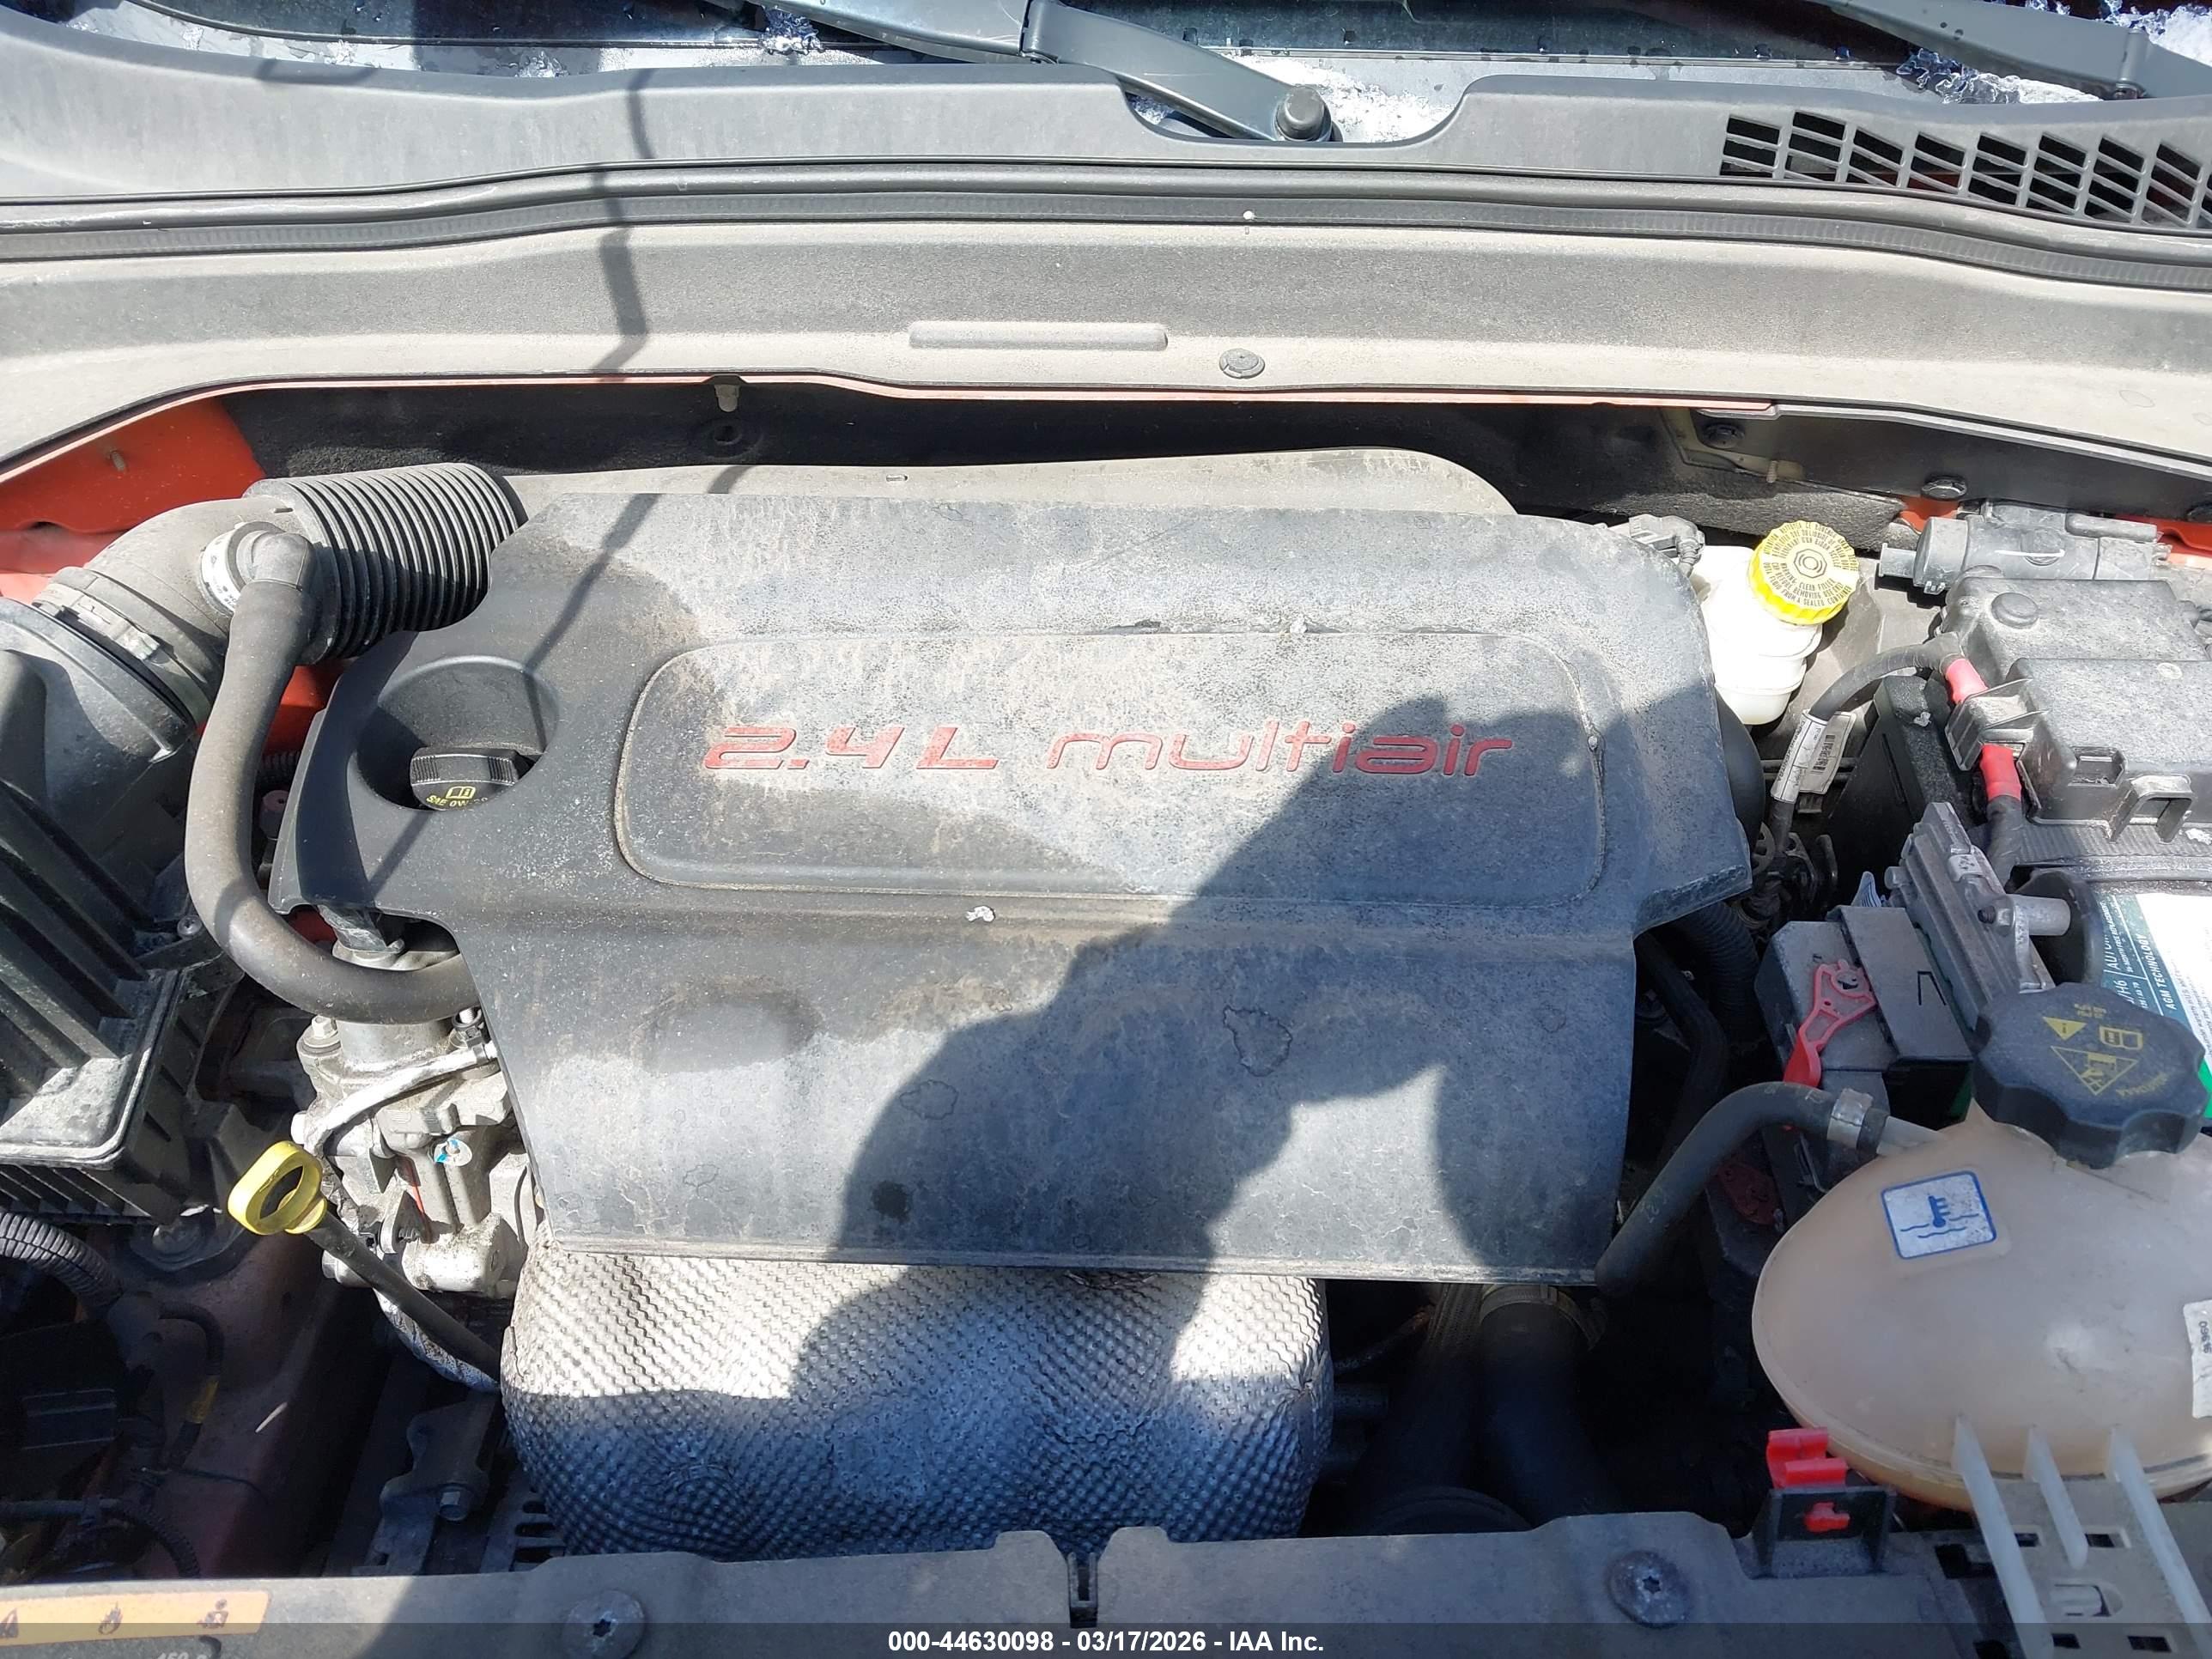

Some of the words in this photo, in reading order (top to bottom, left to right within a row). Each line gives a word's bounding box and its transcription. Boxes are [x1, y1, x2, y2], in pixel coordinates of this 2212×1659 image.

[1048, 720, 1512, 776] multiair
[426, 795, 447, 806] SAE
[2136, 933, 2167, 988] TECHNOLOGY
[2160, 989, 2177, 1010] AGM
